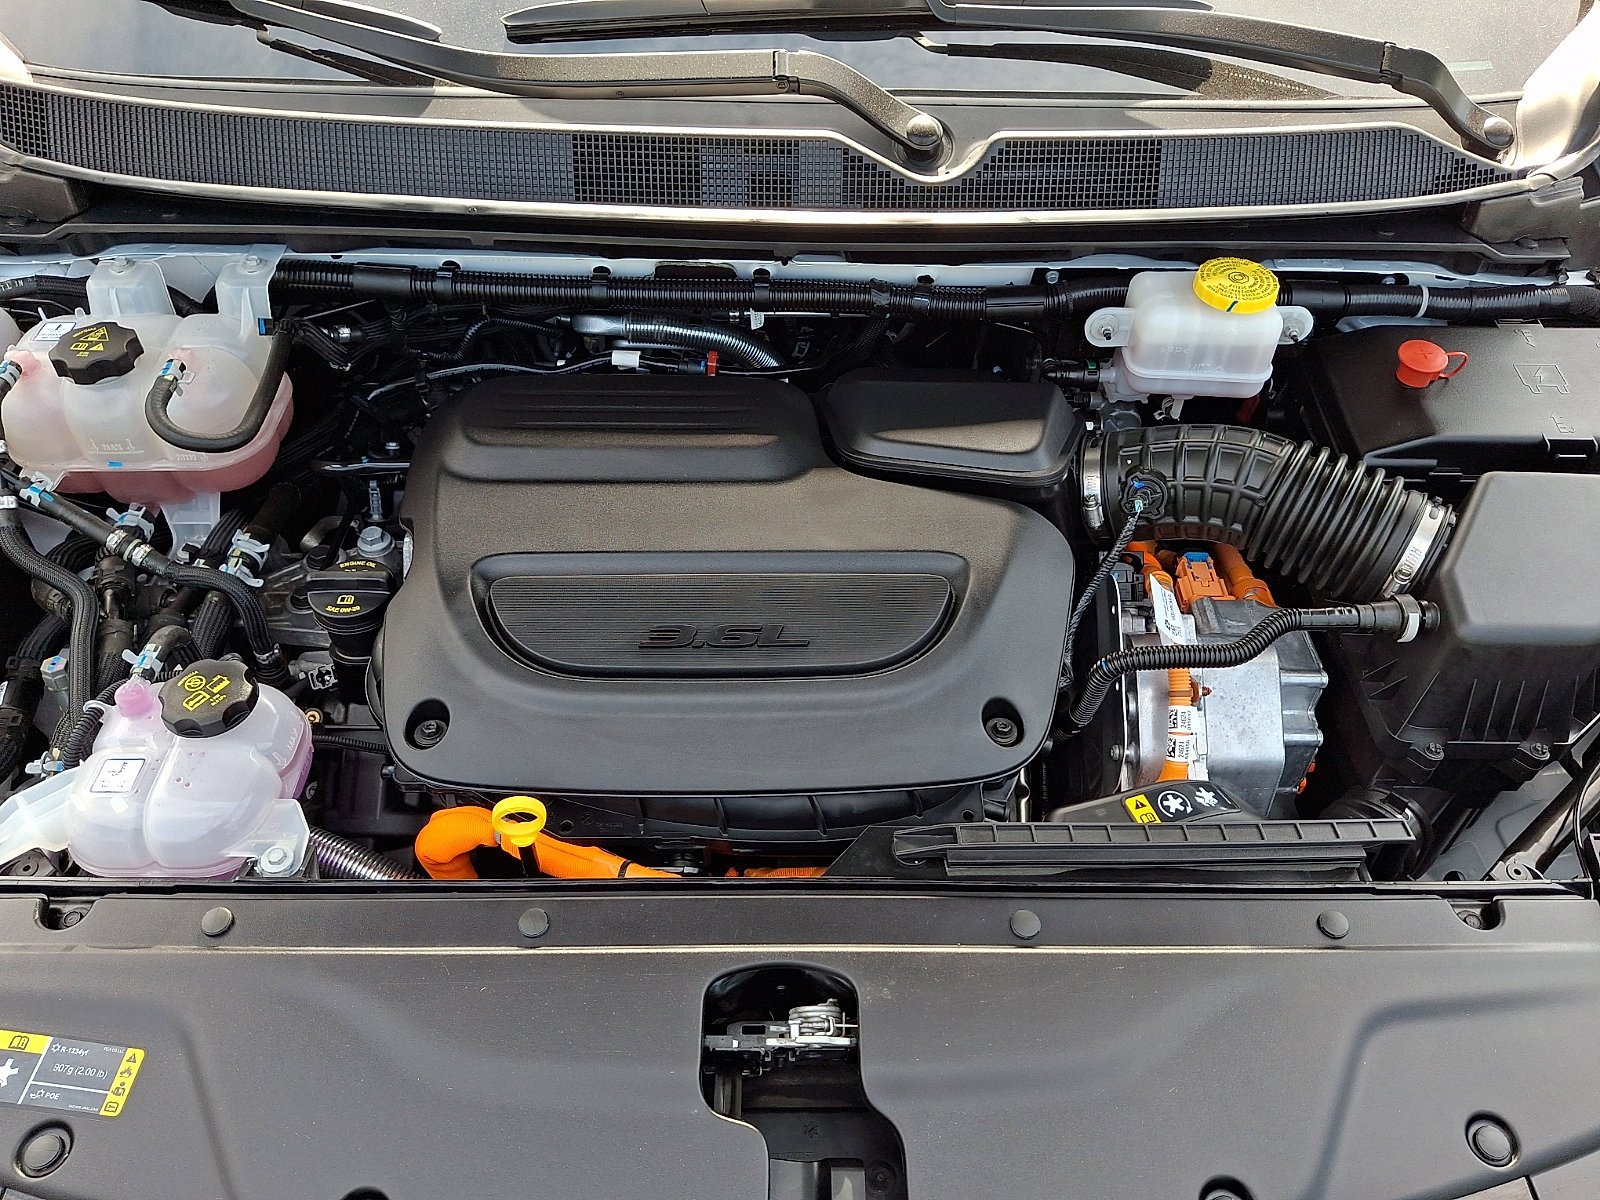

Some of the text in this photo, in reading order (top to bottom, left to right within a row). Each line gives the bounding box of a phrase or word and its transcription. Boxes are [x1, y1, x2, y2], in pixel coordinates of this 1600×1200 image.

[339, 560, 366, 568] ENGINE
[638, 624, 810, 649] 3.6L
[60, 1046, 90, 1057] R-1234yf
[53, 1063, 108, 1080] 907g (2.00 lb)
[44, 1091, 61, 1100] POE
